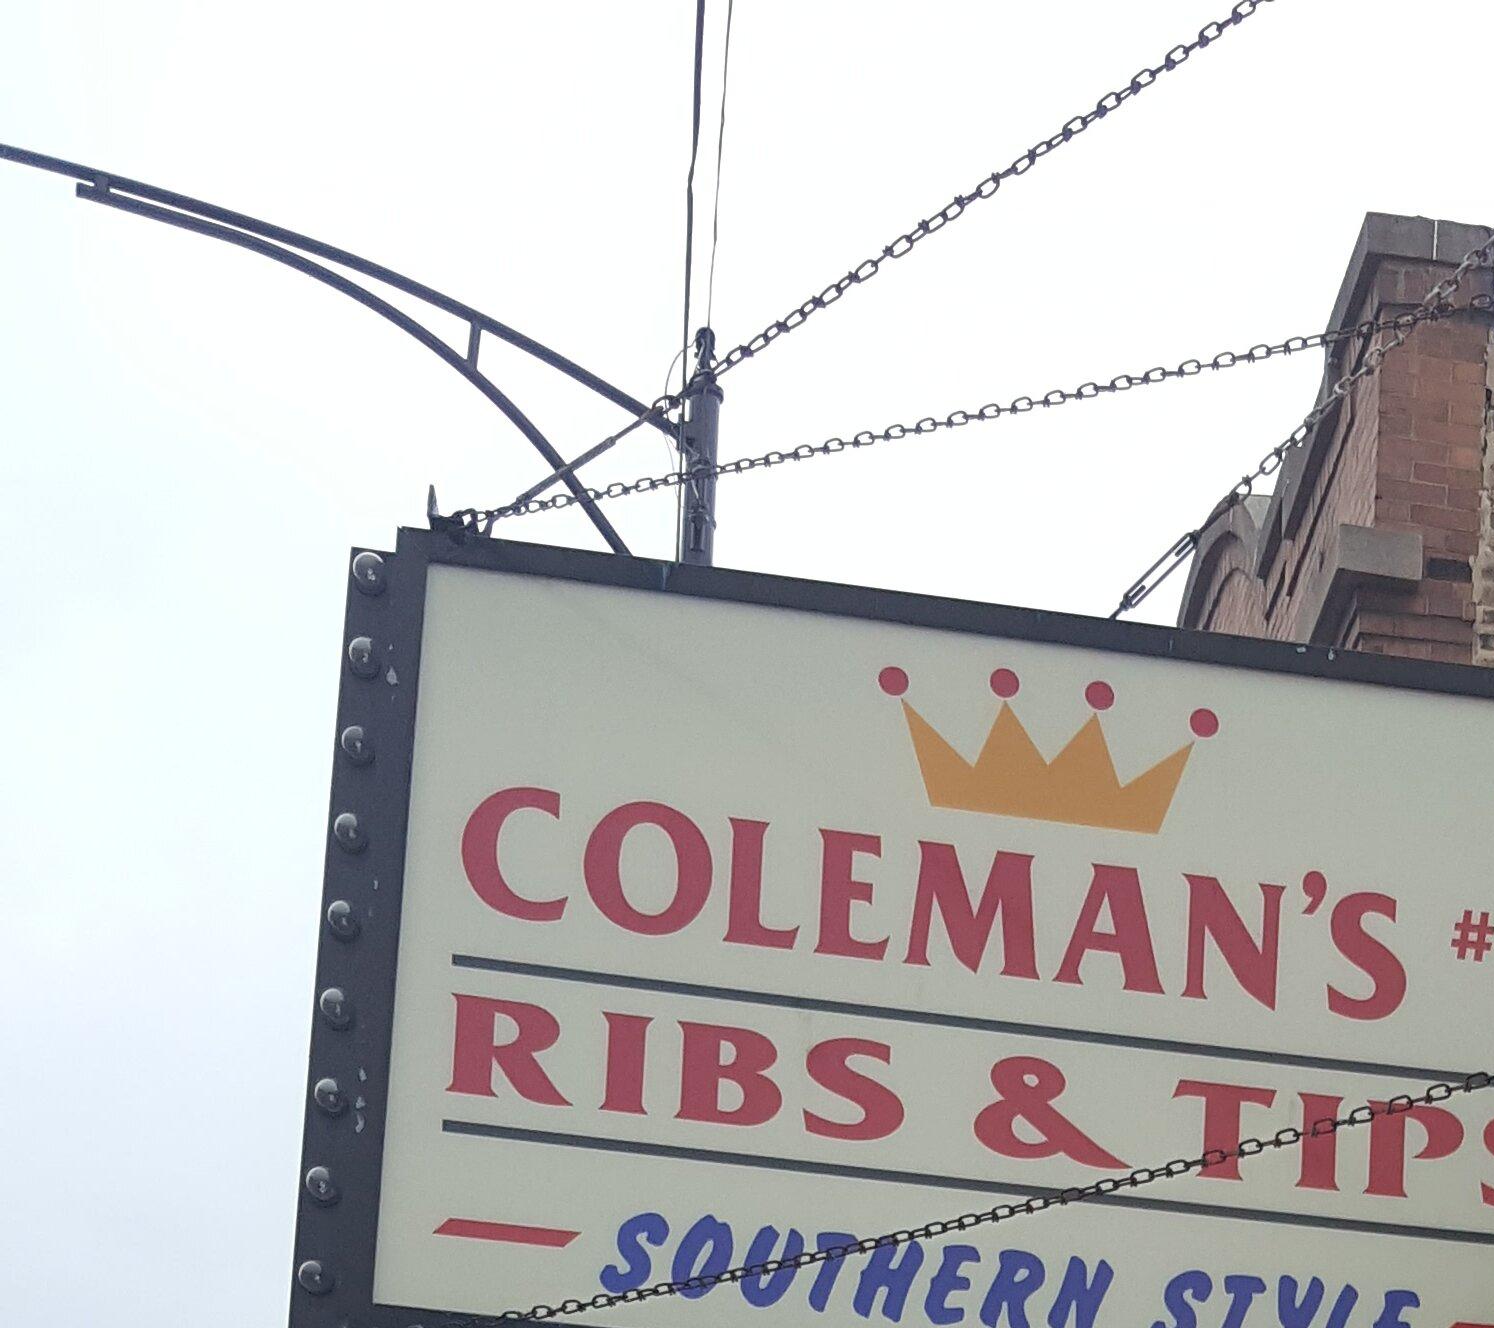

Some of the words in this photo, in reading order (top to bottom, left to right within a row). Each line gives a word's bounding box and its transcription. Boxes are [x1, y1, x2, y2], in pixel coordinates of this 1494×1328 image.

[460, 785, 1408, 1021] COLEMAN'S
[444, 990, 907, 1142] RIBS
[972, 1054, 1134, 1170] &
